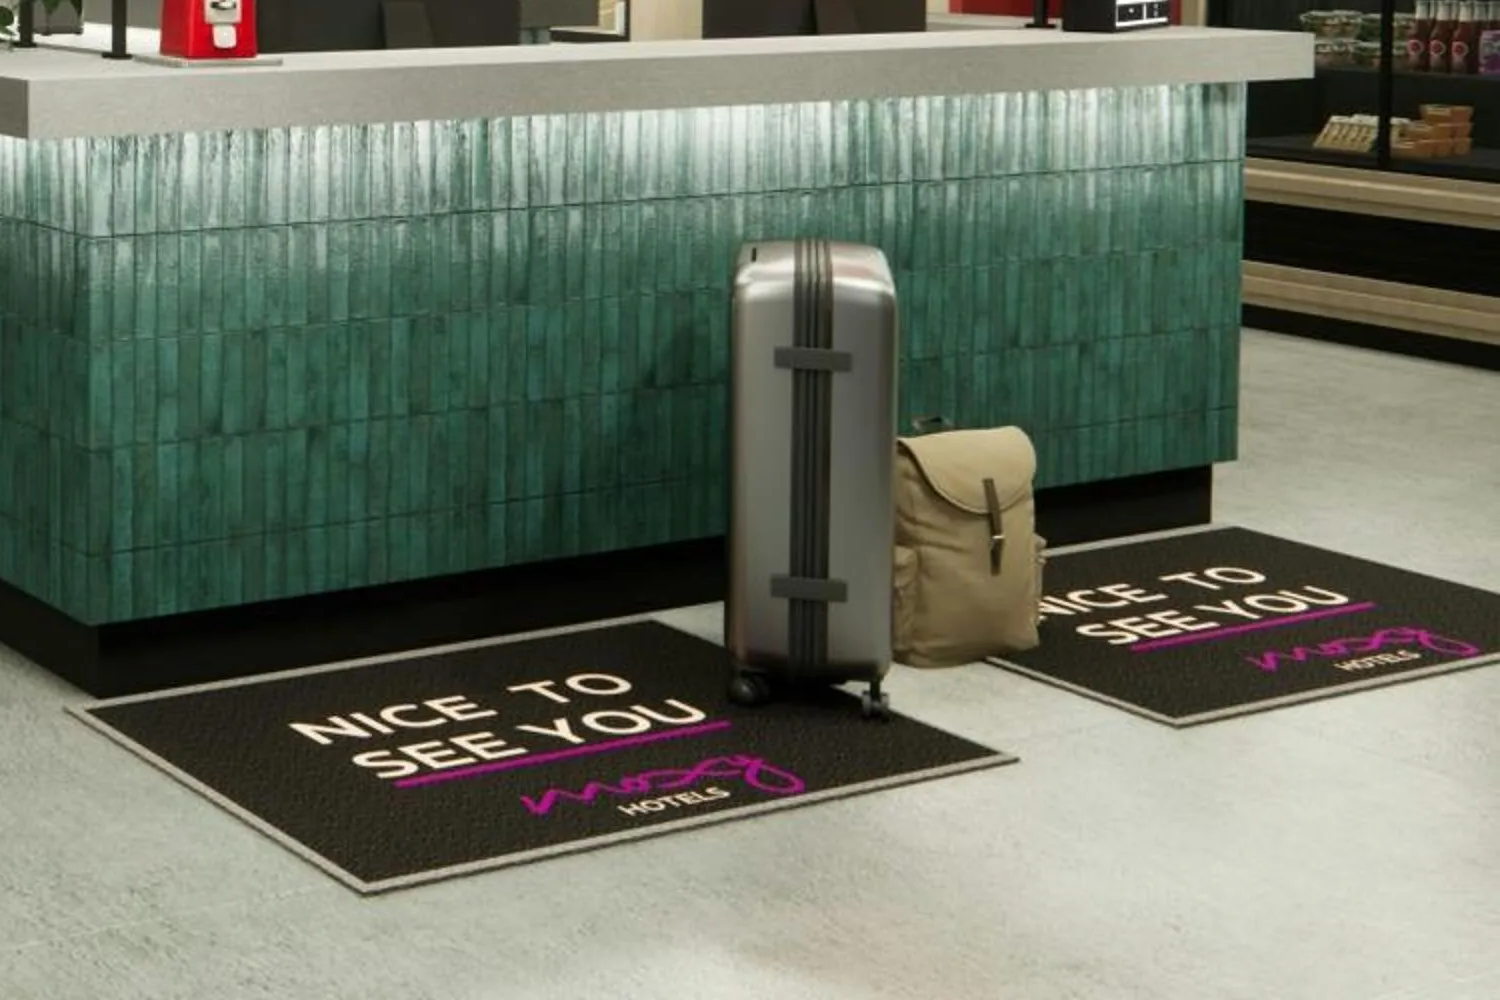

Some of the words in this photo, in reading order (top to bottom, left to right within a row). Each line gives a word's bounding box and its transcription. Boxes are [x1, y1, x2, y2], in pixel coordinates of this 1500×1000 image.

[1159, 566, 1266, 590] TO
[1076, 609, 1221, 645] SEE
[1192, 585, 1349, 620] YOU
[1333, 648, 1421, 672] HOTELS
[289, 694, 498, 745] NICE
[507, 673, 632, 704] TO
[352, 731, 529, 779] SEE
[516, 699, 707, 745] YOU
[618, 786, 731, 816] HOTELS
